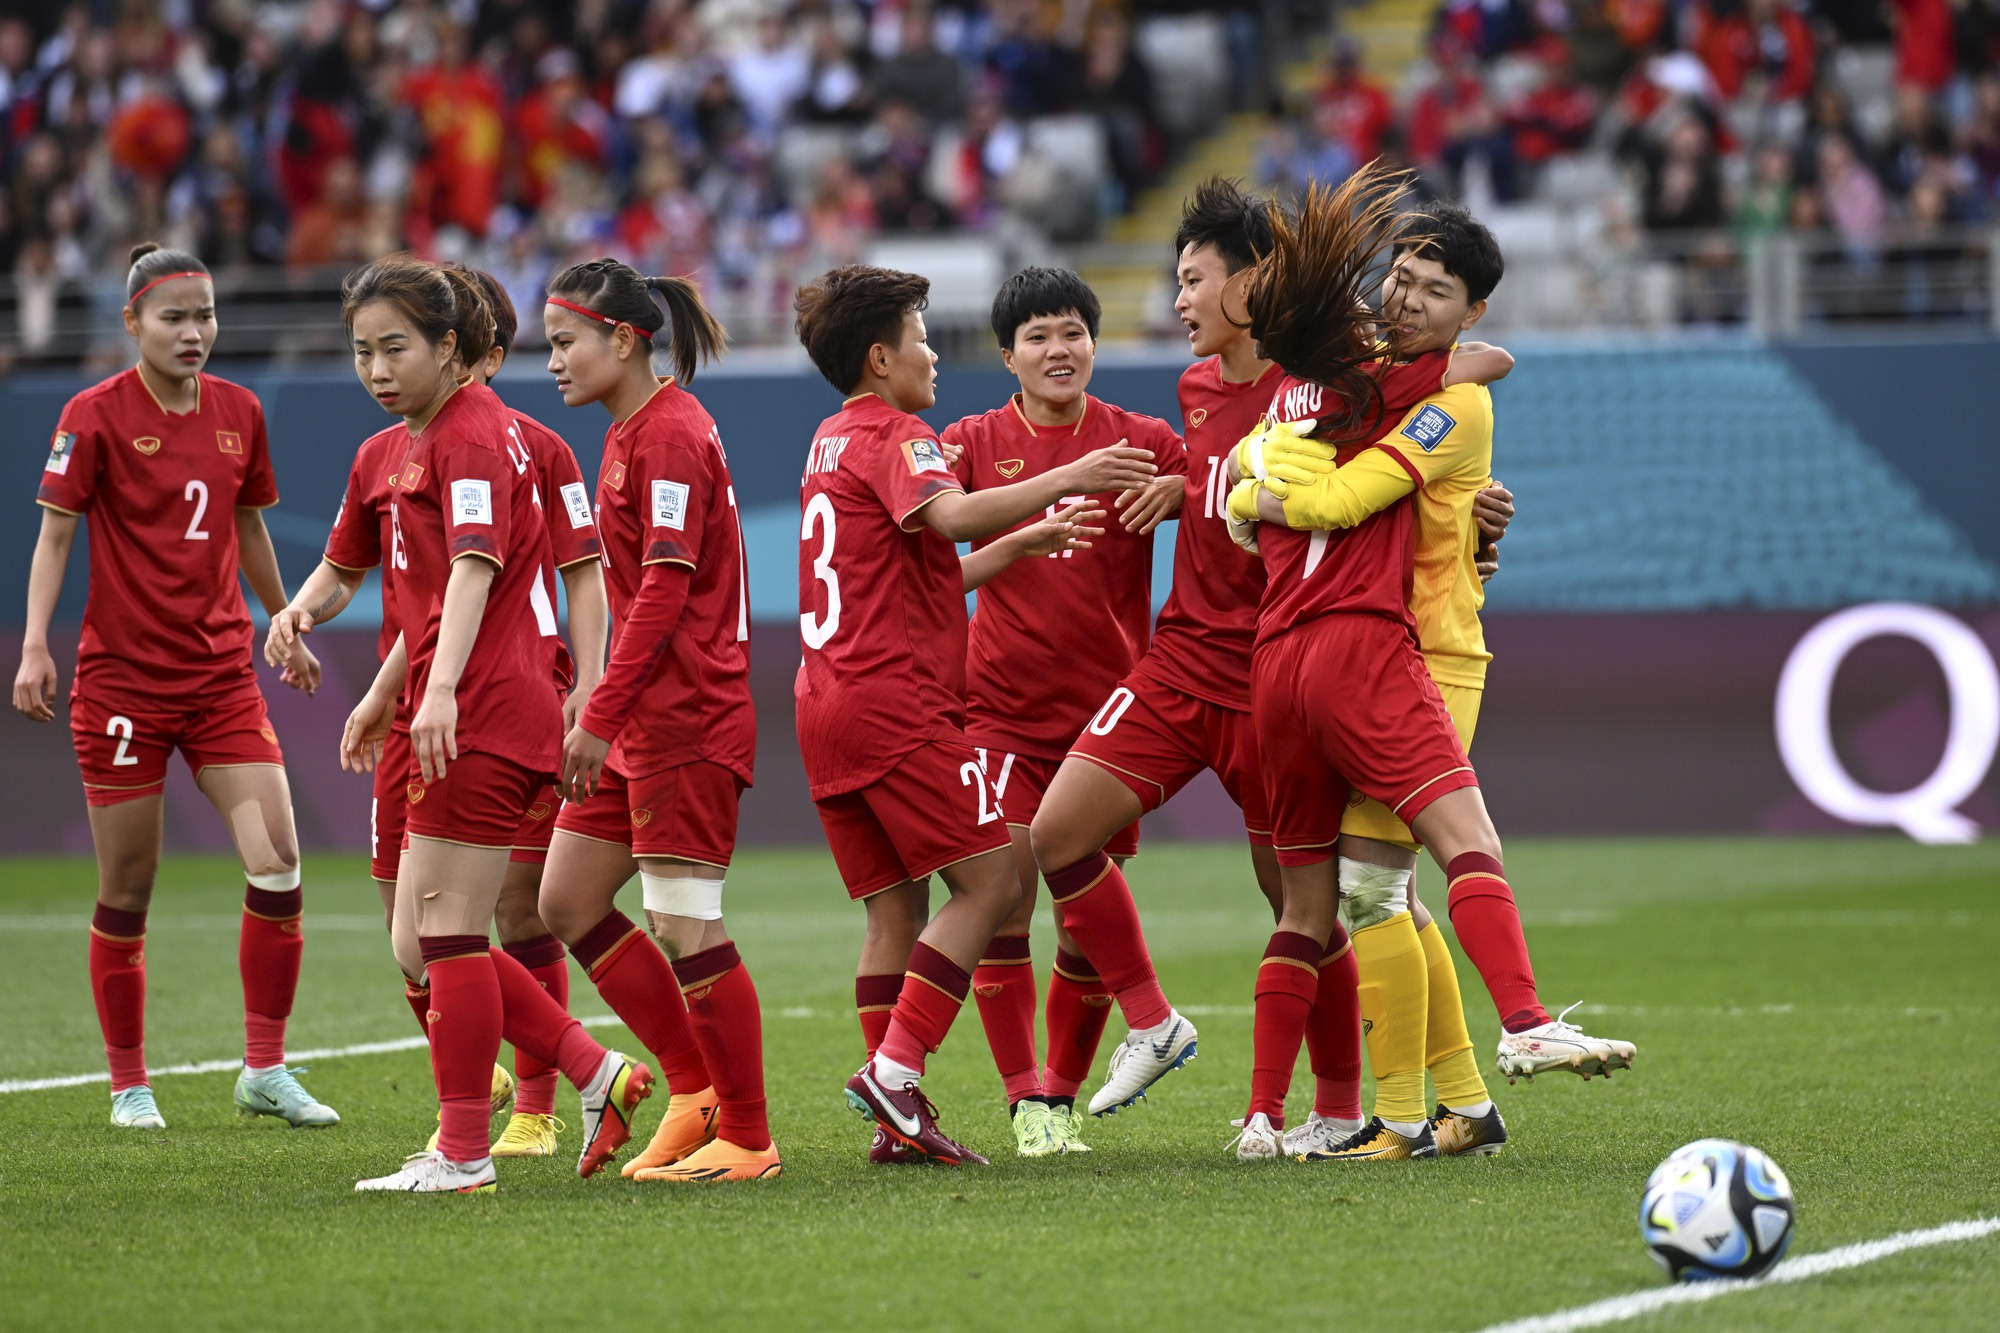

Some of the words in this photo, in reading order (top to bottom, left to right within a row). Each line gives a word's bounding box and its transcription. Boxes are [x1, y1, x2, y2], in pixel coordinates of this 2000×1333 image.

[1421, 414, 1443, 432] UNITES
[184, 480, 209, 540] 2
[460, 494, 482, 502] UNITES
[659, 495, 679, 506] UNITES
[801, 492, 841, 650] 3
[107, 716, 138, 766] 2
[1775, 602, 2000, 843] Q
